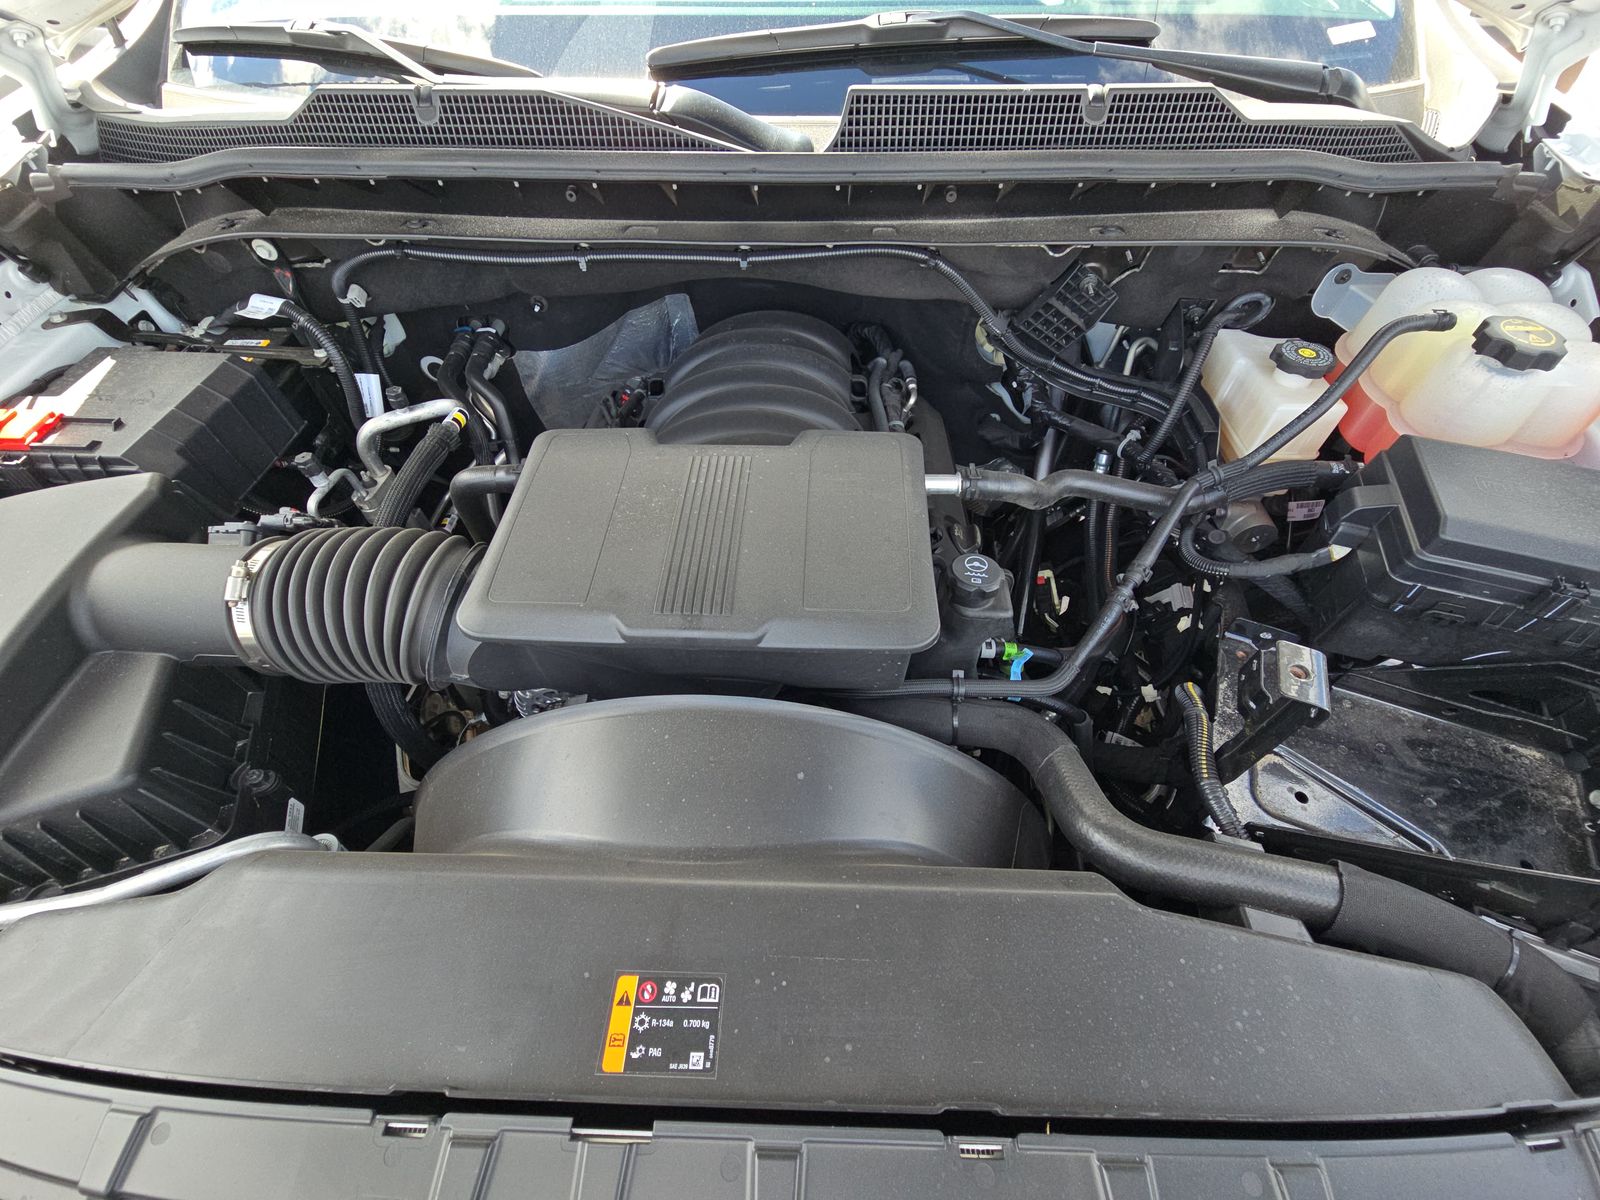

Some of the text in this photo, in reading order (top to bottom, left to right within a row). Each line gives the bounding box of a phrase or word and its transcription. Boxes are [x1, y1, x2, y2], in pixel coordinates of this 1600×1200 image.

[661, 995, 677, 1003] AUTO
[651, 1019, 710, 1029] R-134a 0.700 kg
[648, 1047, 662, 1057] PAG
